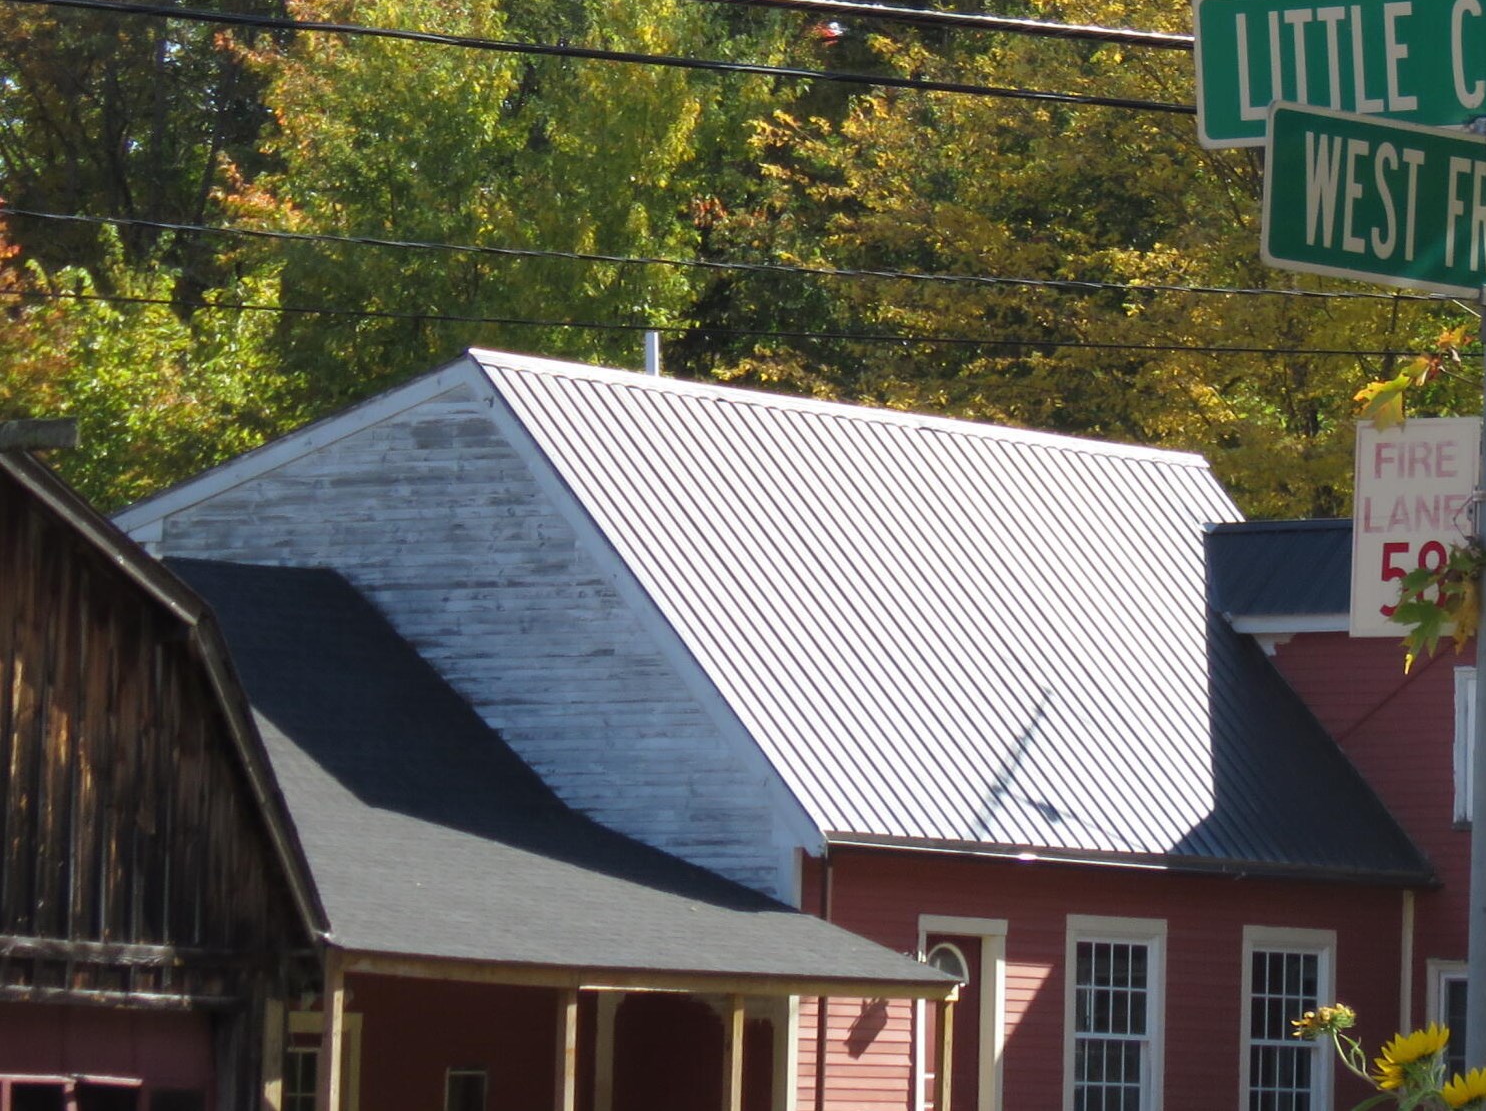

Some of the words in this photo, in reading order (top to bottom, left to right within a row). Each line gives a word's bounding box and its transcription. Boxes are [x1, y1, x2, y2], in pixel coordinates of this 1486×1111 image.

[1235, 1, 1418, 122] LITTLE
[1304, 130, 1426, 263] WEST
[1373, 440, 1459, 480] FIRE
[1363, 493, 1467, 534] LANE
